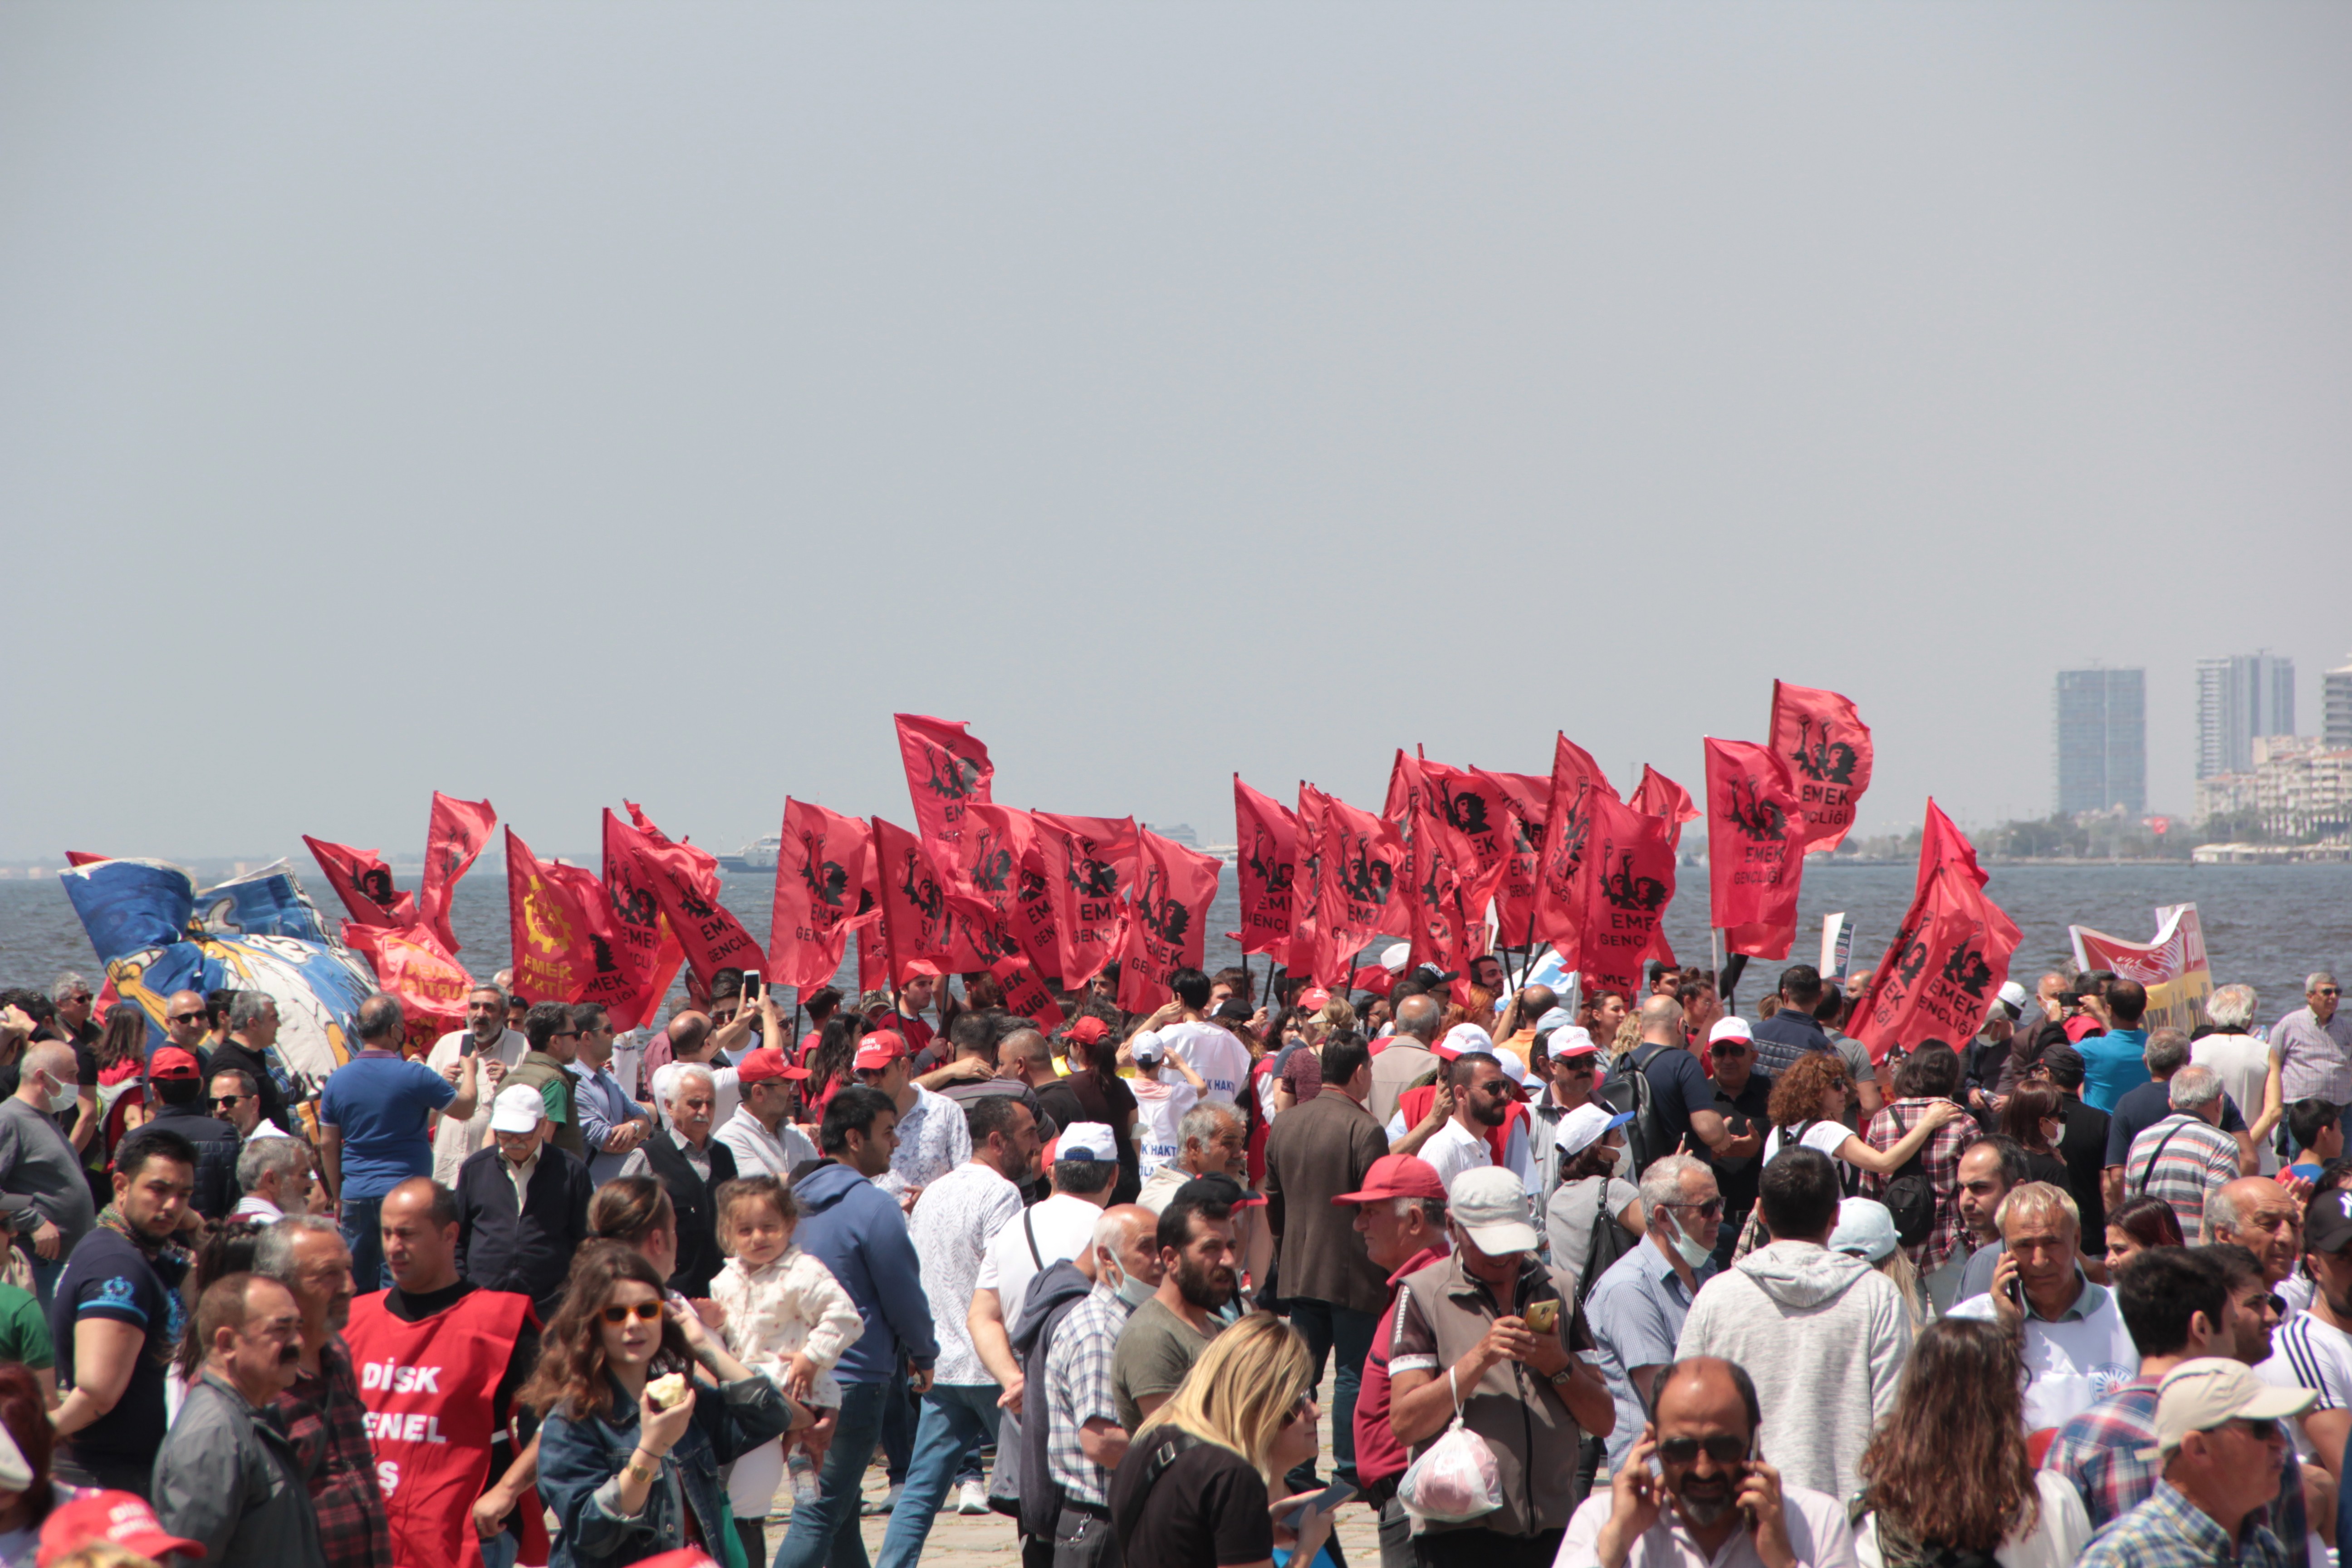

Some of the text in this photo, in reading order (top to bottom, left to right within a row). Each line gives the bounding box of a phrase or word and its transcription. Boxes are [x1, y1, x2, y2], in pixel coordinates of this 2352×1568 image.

[1802, 784, 1850, 806] EMEK
[1745, 845, 1786, 863] EMEK
[1734, 866, 1784, 885] GENÇLİĞİ
[1080, 903, 1120, 921] EM
[700, 916, 735, 942] EM
[524, 953, 573, 981] EMEK
[584, 973, 630, 993] MEK
[1002, 969, 1027, 993] EK
[1928, 977, 1982, 1020] EMEK
[362, 1357, 442, 1394] DİSK
[374, 1461, 399, 1498] Ş
